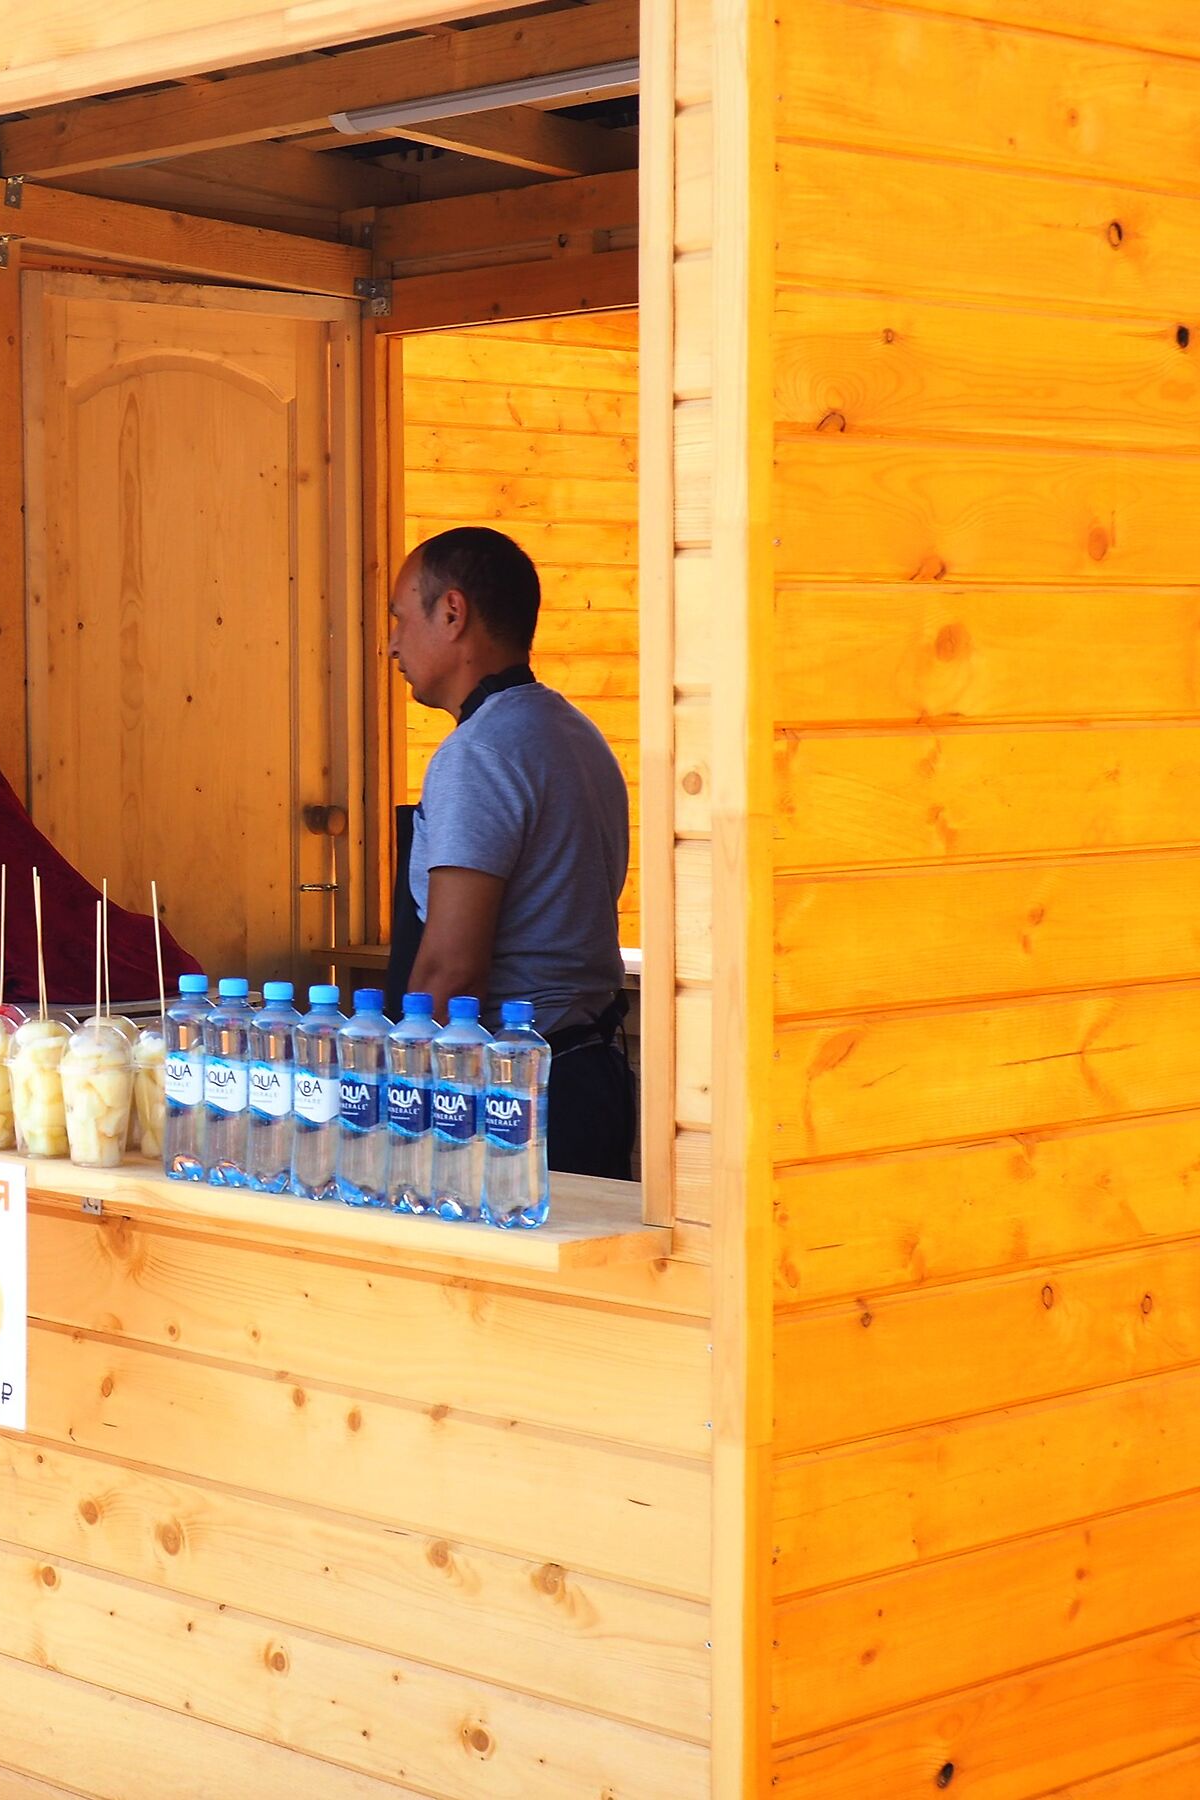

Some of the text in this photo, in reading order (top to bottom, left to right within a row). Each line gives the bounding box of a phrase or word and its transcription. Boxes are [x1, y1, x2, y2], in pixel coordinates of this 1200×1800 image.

[166, 1064, 192, 1081] QUA
[206, 1070, 236, 1087] QUA
[250, 1073, 280, 1090] QUA
[297, 1080, 322, 1097] КВА
[340, 1084, 370, 1104] QUA
